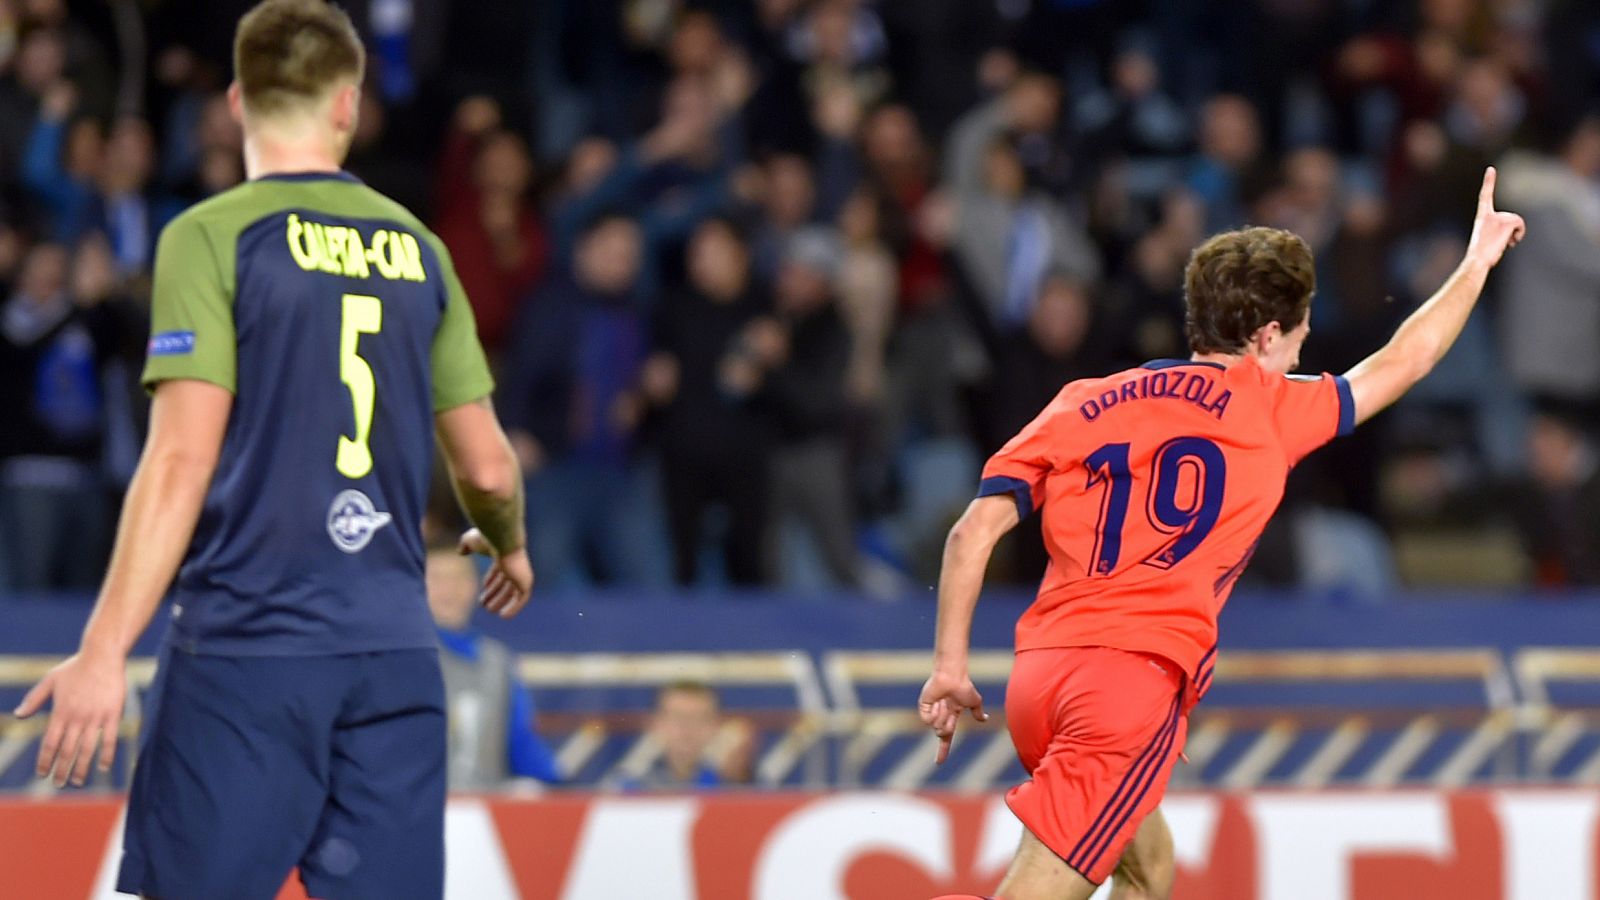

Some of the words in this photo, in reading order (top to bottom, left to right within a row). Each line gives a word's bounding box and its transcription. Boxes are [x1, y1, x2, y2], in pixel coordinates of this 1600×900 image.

[336, 294, 382, 478] 5
[1079, 371, 1232, 422] ODRIOZOLA
[1085, 436, 1227, 577] 19
